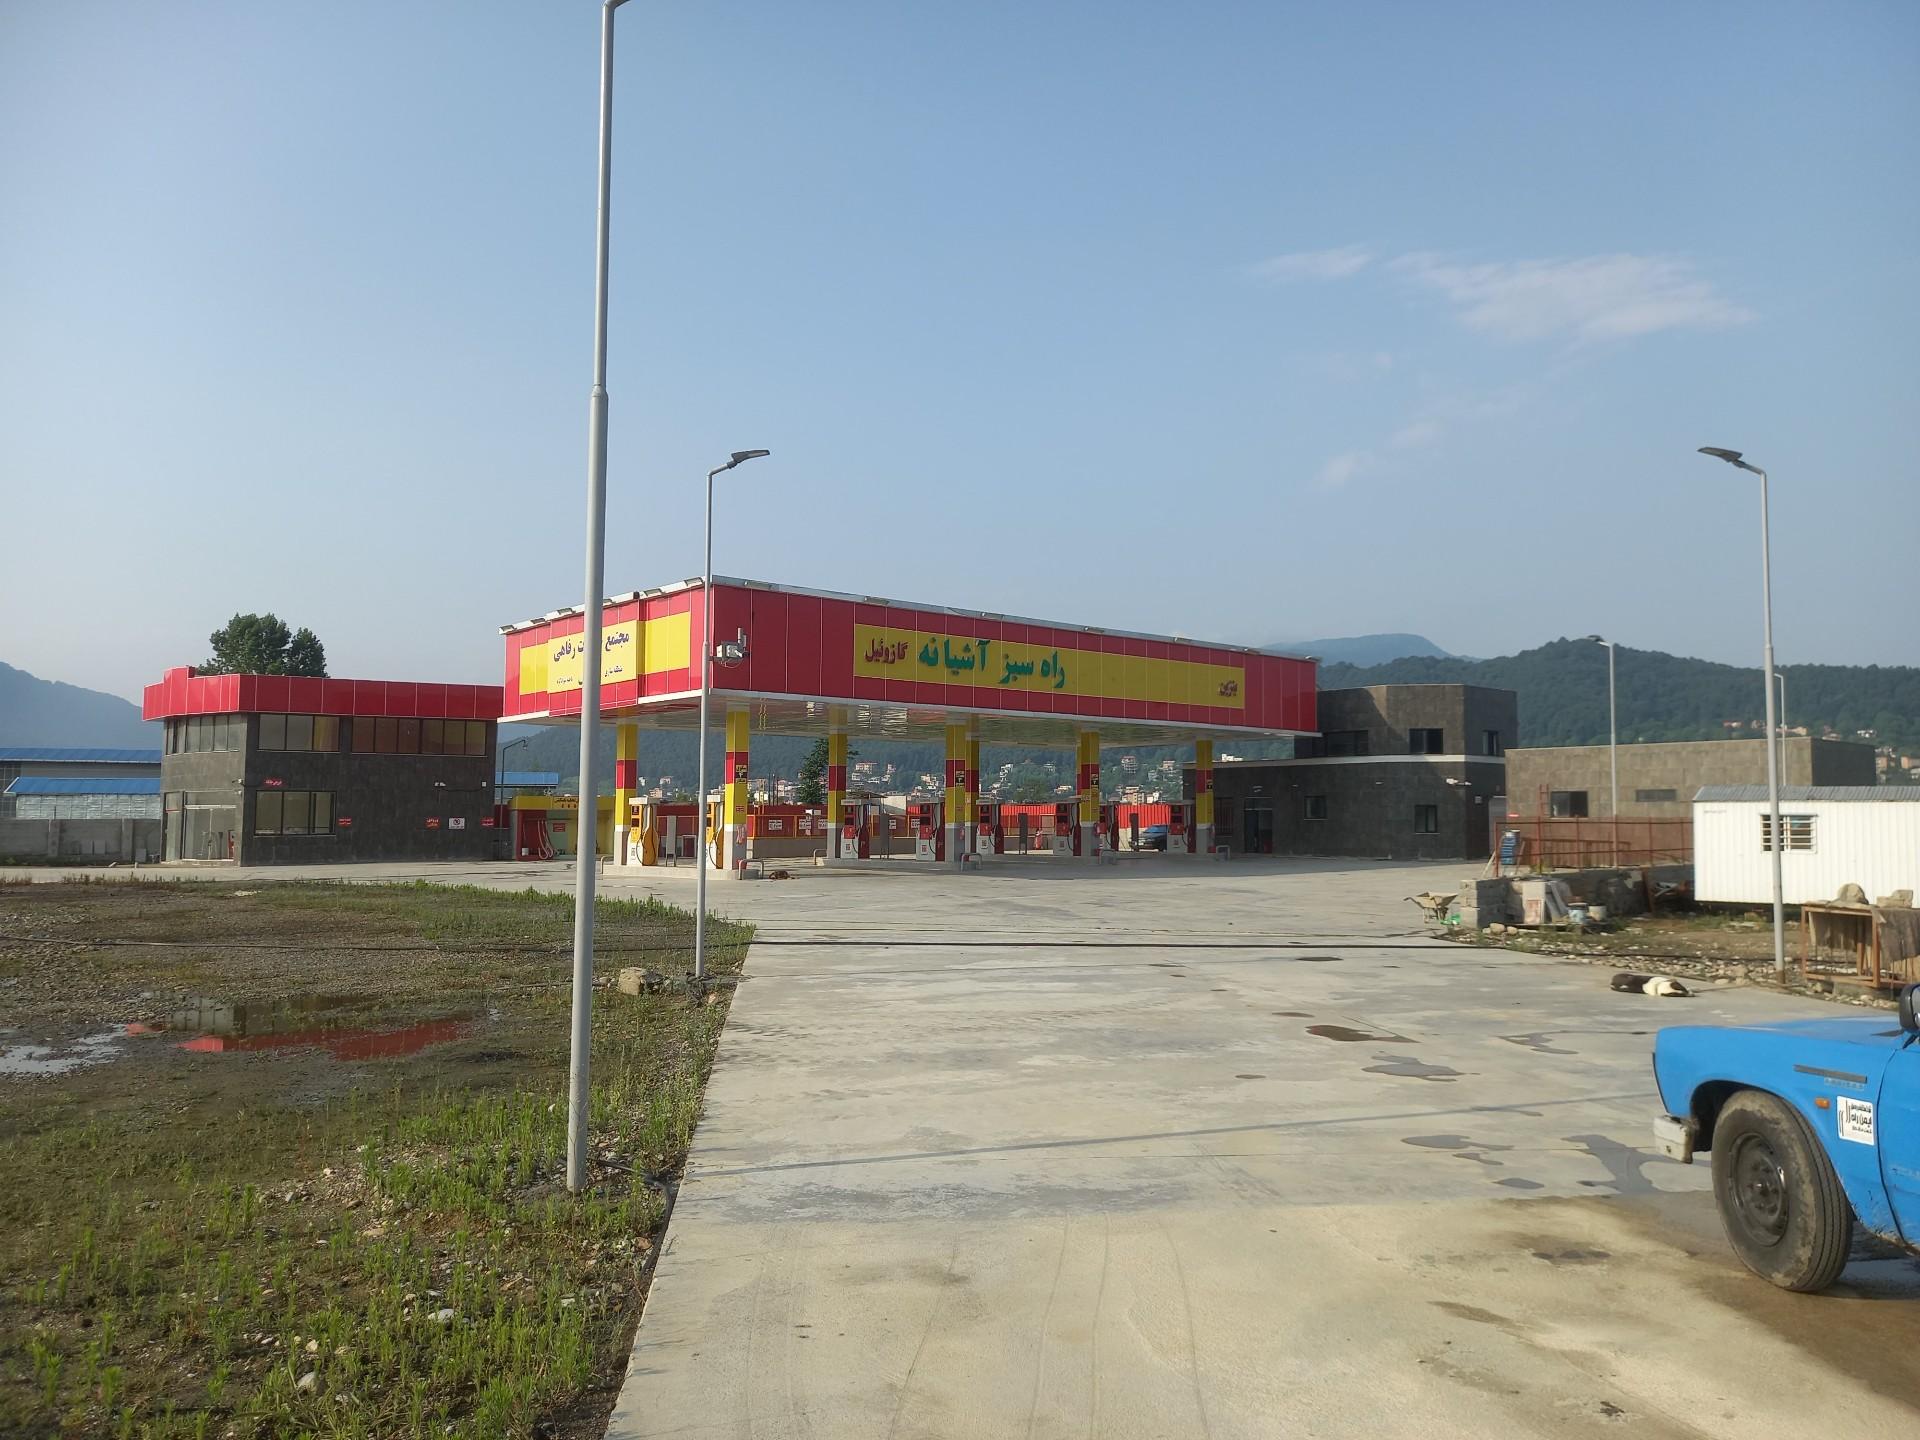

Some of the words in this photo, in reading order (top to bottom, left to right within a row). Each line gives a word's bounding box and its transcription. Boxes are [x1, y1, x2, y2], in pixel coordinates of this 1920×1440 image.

[553, 638, 576, 662] رفاهی
[604, 631, 630, 652] مجتمع
[864, 637, 909, 665] گازوئیل
[918, 636, 991, 676] آشیانه
[998, 653, 1034, 684] سبز
[1040, 649, 1065, 688] راه
